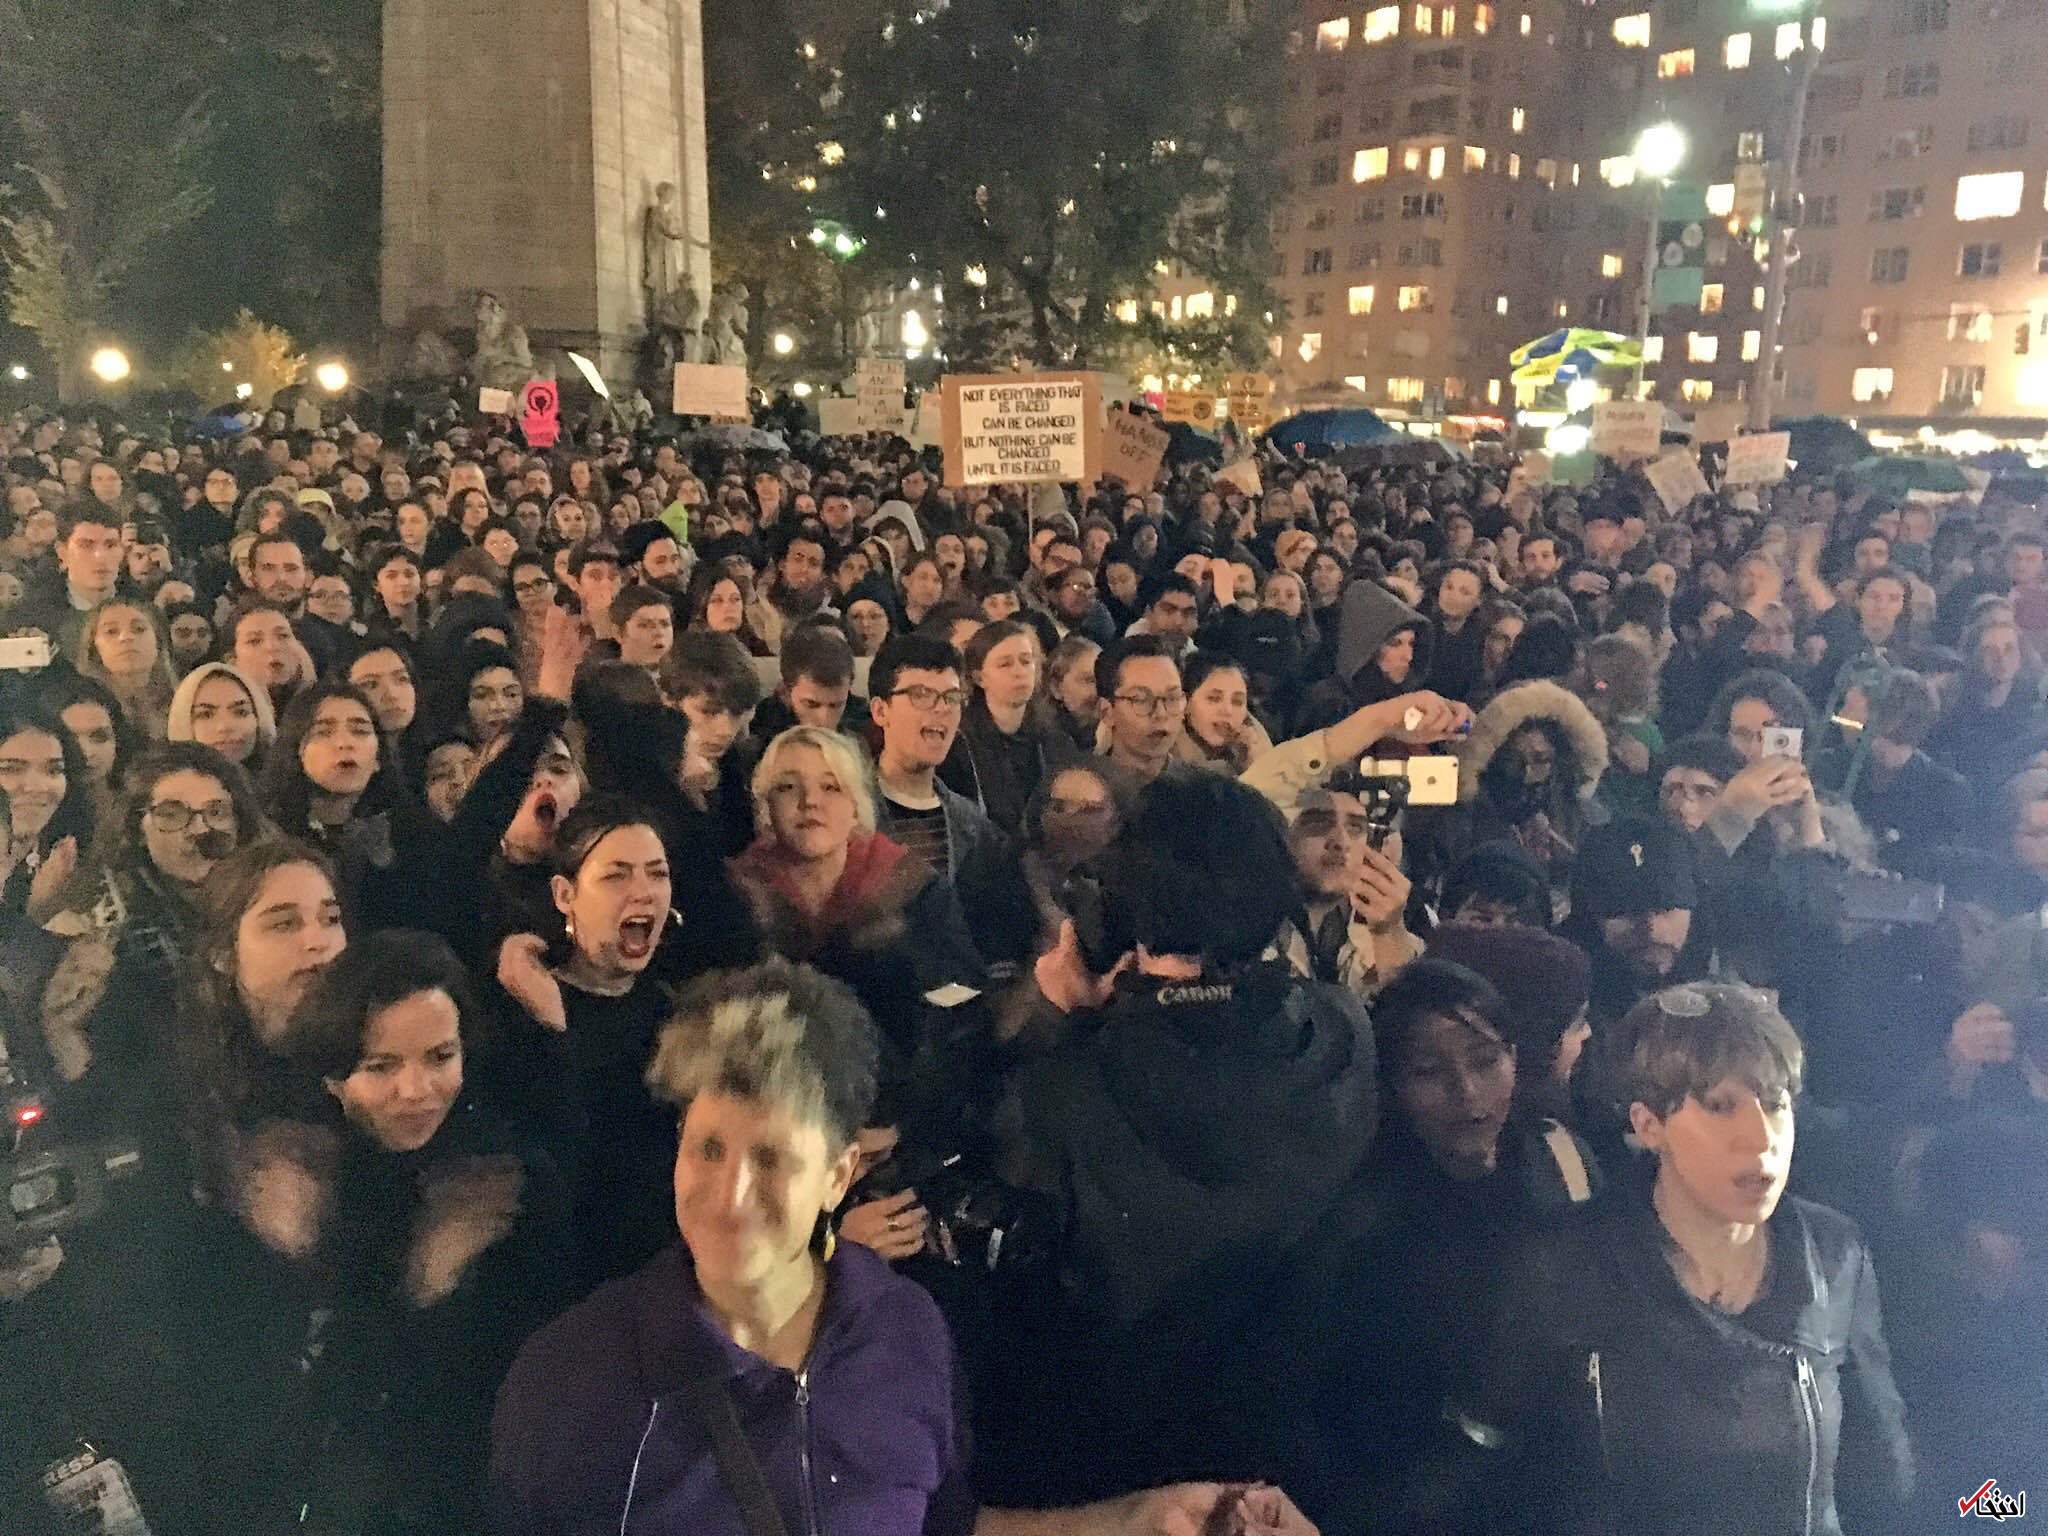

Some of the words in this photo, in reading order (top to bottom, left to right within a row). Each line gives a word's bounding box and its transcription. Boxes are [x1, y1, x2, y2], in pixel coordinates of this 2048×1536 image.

[963, 389, 985, 402] NOT
[989, 387, 1056, 401] EVERYTHING
[1058, 385, 1082, 399] THAT
[999, 401, 1011, 413] IS
[1015, 400, 1050, 412] FACED
[982, 417, 1005, 430] CAN
[1008, 417, 1022, 429] BE
[1025, 415, 1075, 429] CHANGED
[963, 436, 985, 449] BUT
[988, 435, 1036, 448] NOTHING
[1039, 434, 1060, 446] CAN
[1062, 433, 1076, 445] BE
[998, 446, 1050, 459] CHANGED
[967, 463, 997, 476] UNTIL
[1000, 463, 1010, 474] IT
[1011, 463, 1021, 474] IS
[1024, 460, 1061, 474] FACED
[1156, 984, 1232, 1006] Canon
